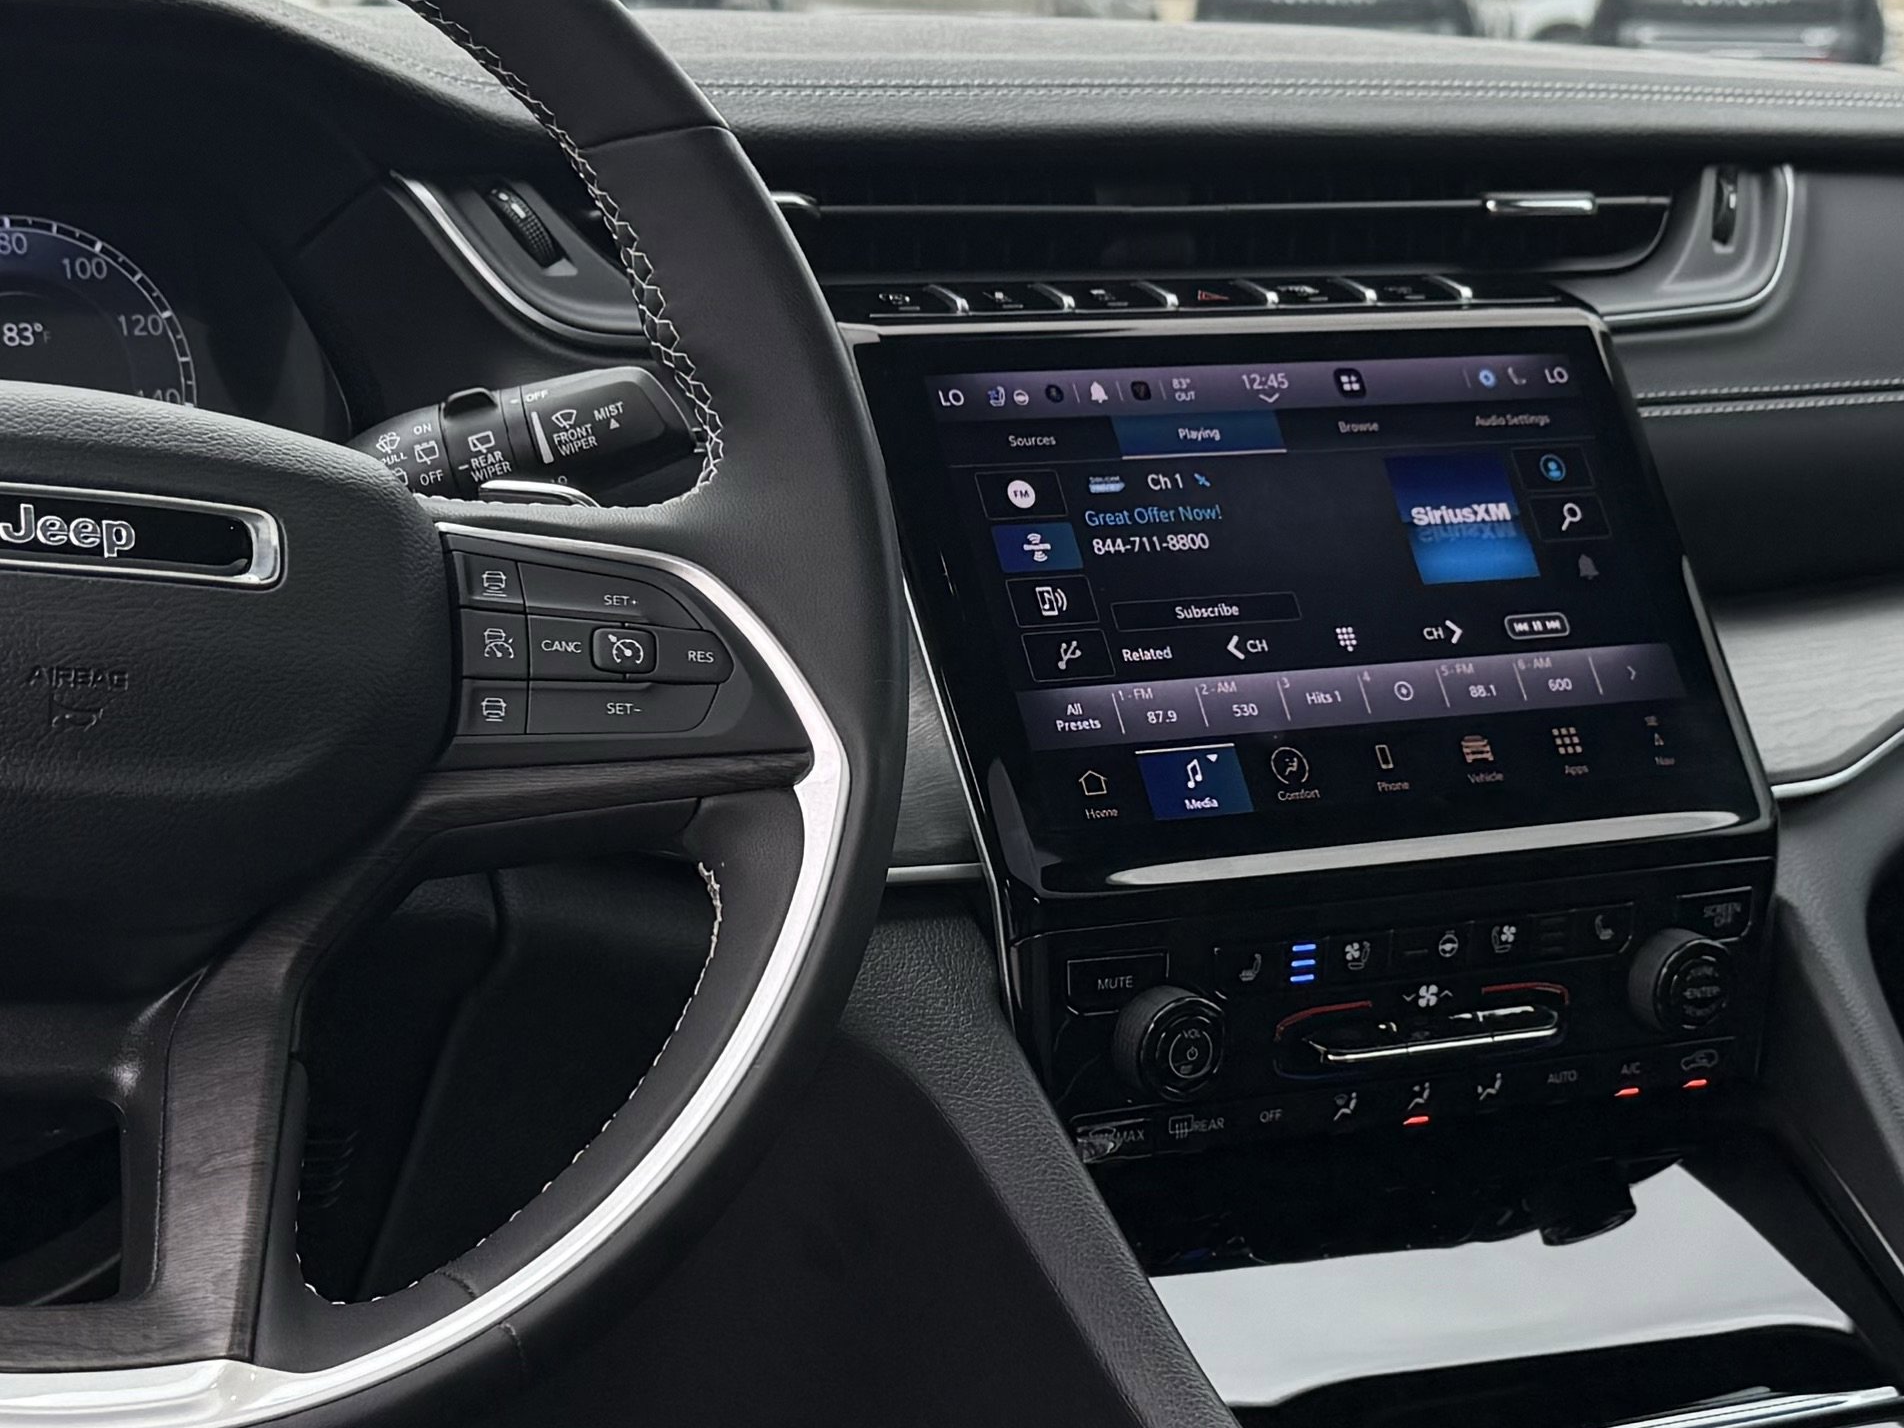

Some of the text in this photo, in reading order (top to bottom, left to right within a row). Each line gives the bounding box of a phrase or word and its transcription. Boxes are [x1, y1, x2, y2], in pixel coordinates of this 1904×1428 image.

[61, 257, 108, 280] 100
[117, 314, 164, 337] 120
[1242, 373, 1289, 390] 12:45
[1544, 366, 1569, 383] LO
[526, 389, 548, 402] OFF
[938, 389, 965, 406] LO
[1175, 390, 1196, 402] OUT
[594, 402, 624, 421] MIST
[1338, 421, 1379, 433] Browse
[1475, 412, 1550, 428] Audio Settings
[413, 423, 432, 436] ON
[553, 424, 593, 444] FRONT
[1178, 427, 1220, 442] Playing
[557, 436, 598, 456] WIPER
[1008, 434, 1056, 447] Sources
[470, 451, 504, 470] REAR
[420, 469, 444, 486] OFF
[471, 461, 512, 483] WIPER
[1147, 473, 1183, 491] Ch 1
[1085, 504, 1223, 526] Great Offer Now!
[1411, 502, 1511, 526] SiriusXM
[1092, 533, 1210, 555] 844-711-8800
[1175, 602, 1239, 619] Subscribe
[1423, 626, 1444, 640] CH
[541, 639, 582, 654] CANC
[1246, 639, 1268, 653] CH
[687, 649, 714, 663] RES
[1122, 646, 1173, 662] Related
[1282, 678, 1290, 688] 3
[1548, 678, 1572, 692] 600
[1306, 690, 1333, 705] Hits
[1468, 684, 1497, 698] 88.1
[1066, 703, 1083, 715] All
[1232, 704, 1258, 717] 530
[1146, 710, 1177, 724] 87.9
[1055, 719, 1101, 732] Presets
[1565, 764, 1589, 776] Apps
[1377, 779, 1410, 792] Phone
[1278, 787, 1320, 801] Comfort
[1185, 798, 1218, 810] Media
[1085, 807, 1118, 820] Home
[1097, 976, 1133, 990] MUTE
[1621, 1062, 1641, 1075] A/C
[1548, 1070, 1577, 1084] AUTO
[1260, 1109, 1283, 1123] OFF
[1195, 1118, 1225, 1132] REAR
